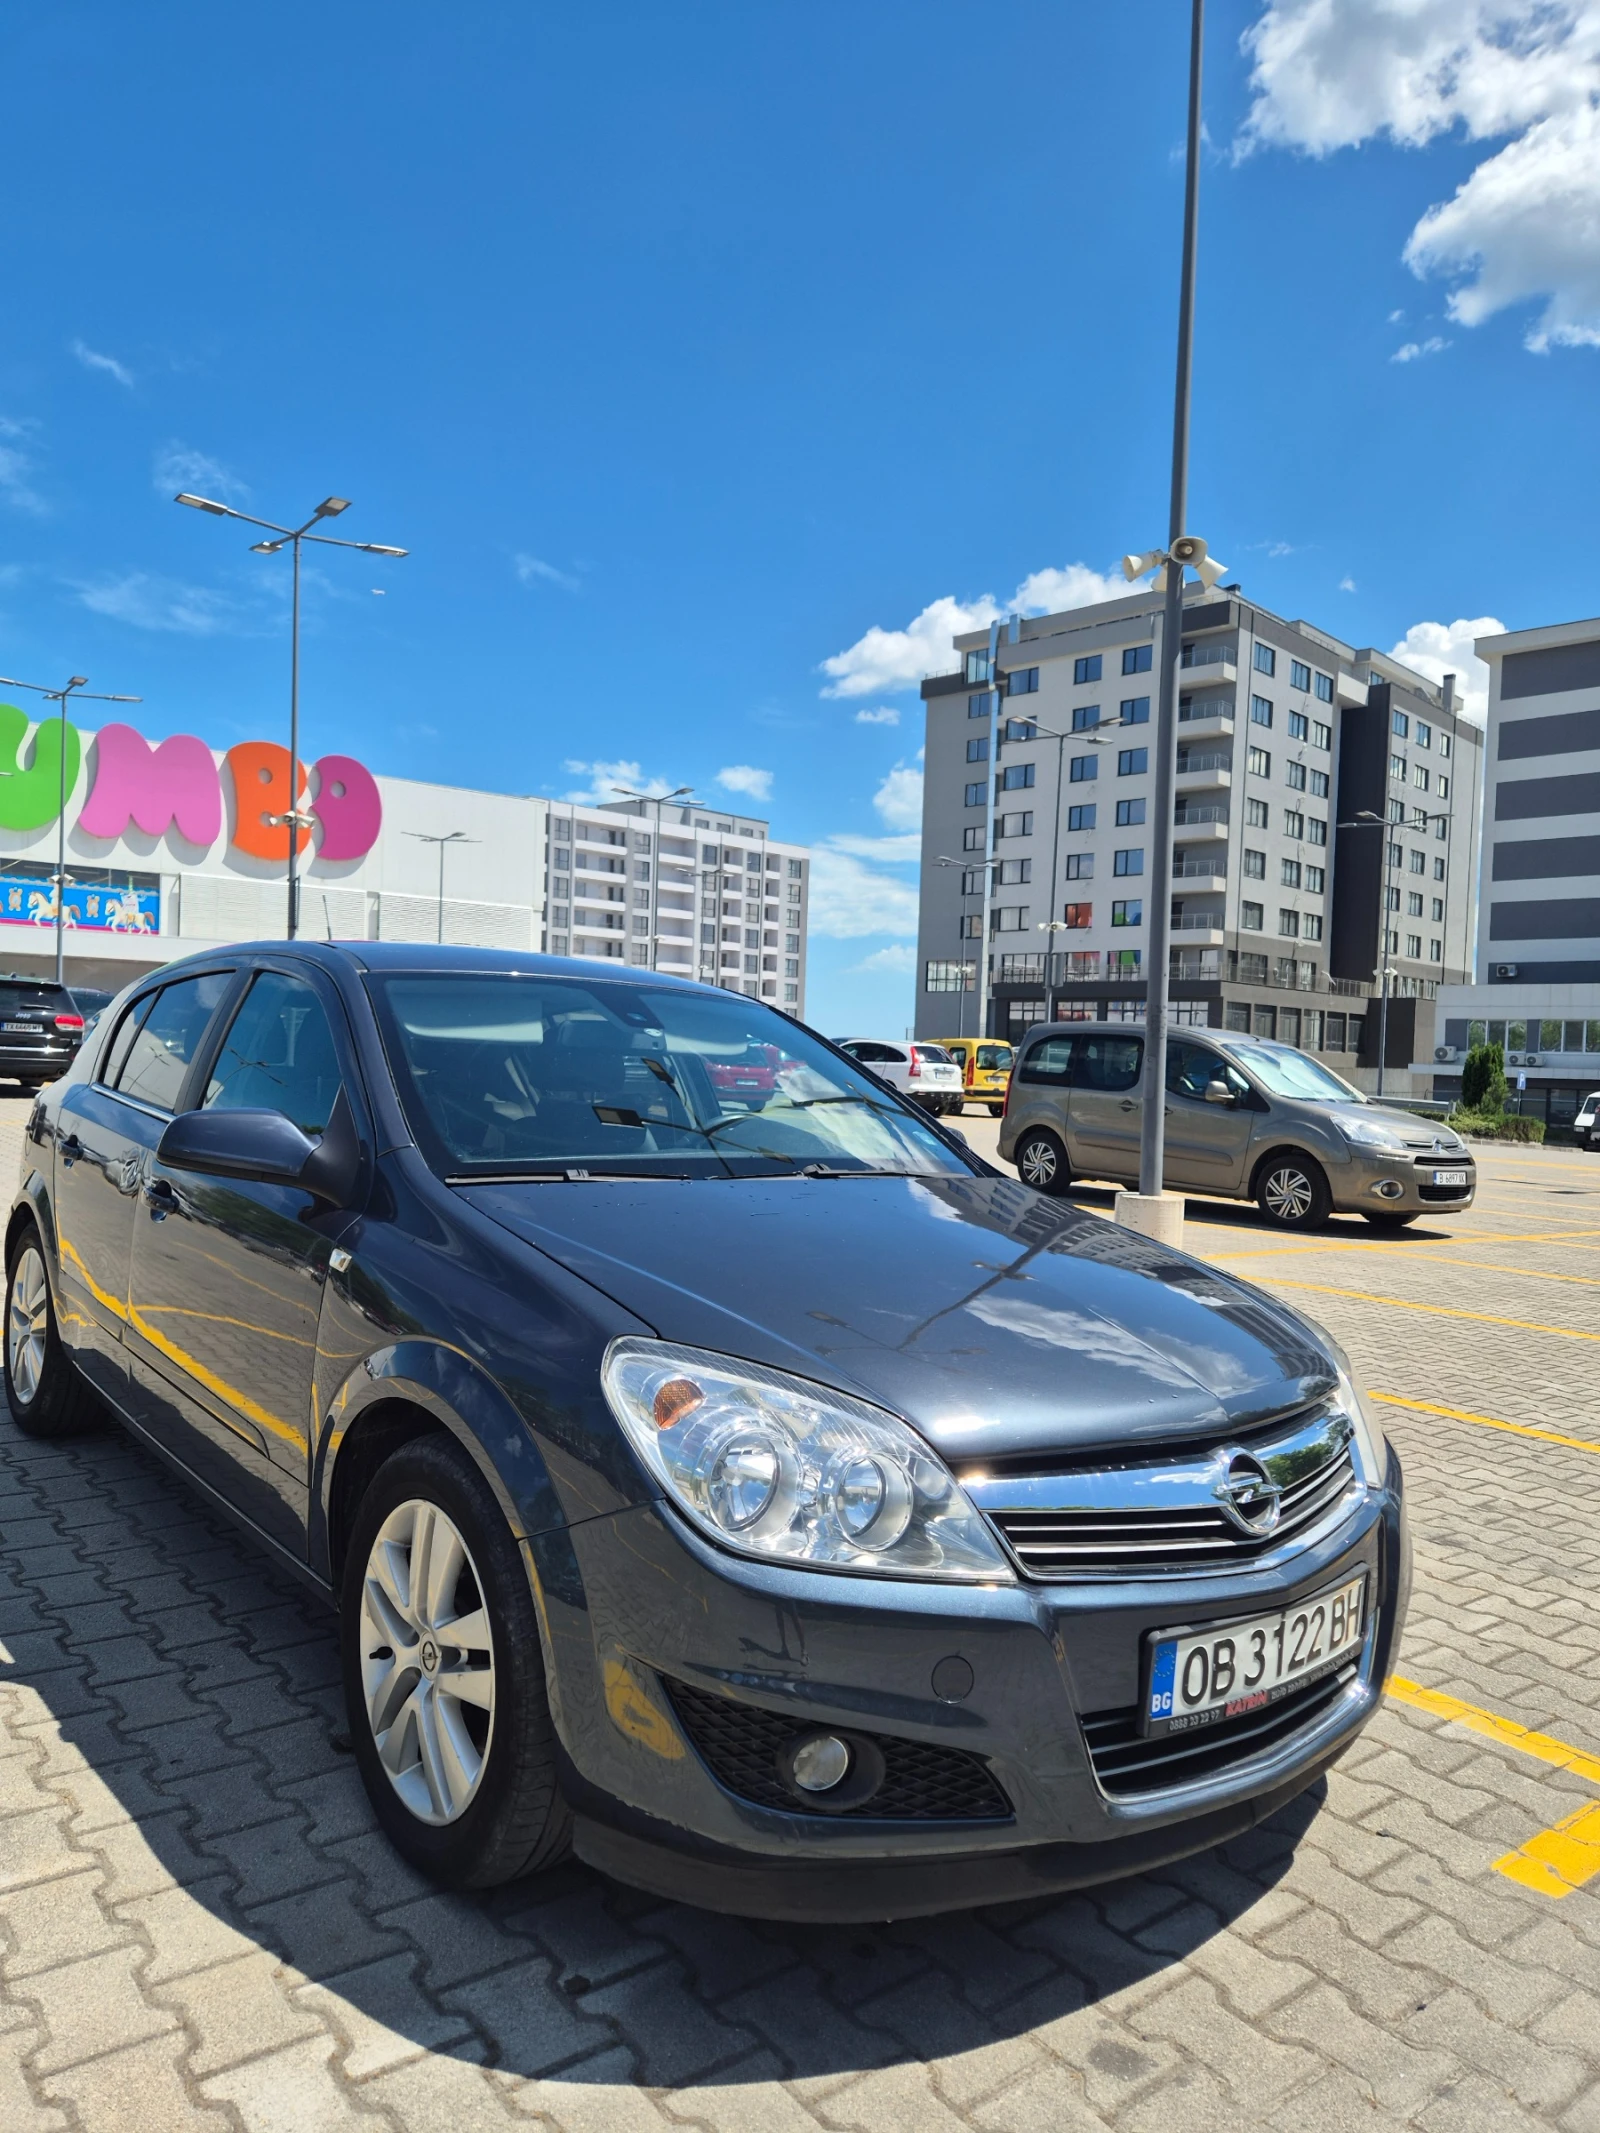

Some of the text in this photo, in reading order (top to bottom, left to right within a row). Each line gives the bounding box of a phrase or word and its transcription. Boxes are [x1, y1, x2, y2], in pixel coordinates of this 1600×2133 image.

[1151, 1692, 1172, 1713] BG
[1181, 1638, 1236, 1706] OB
[1244, 1605, 1326, 1687] 3122
[1329, 1582, 1361, 1651] BH
